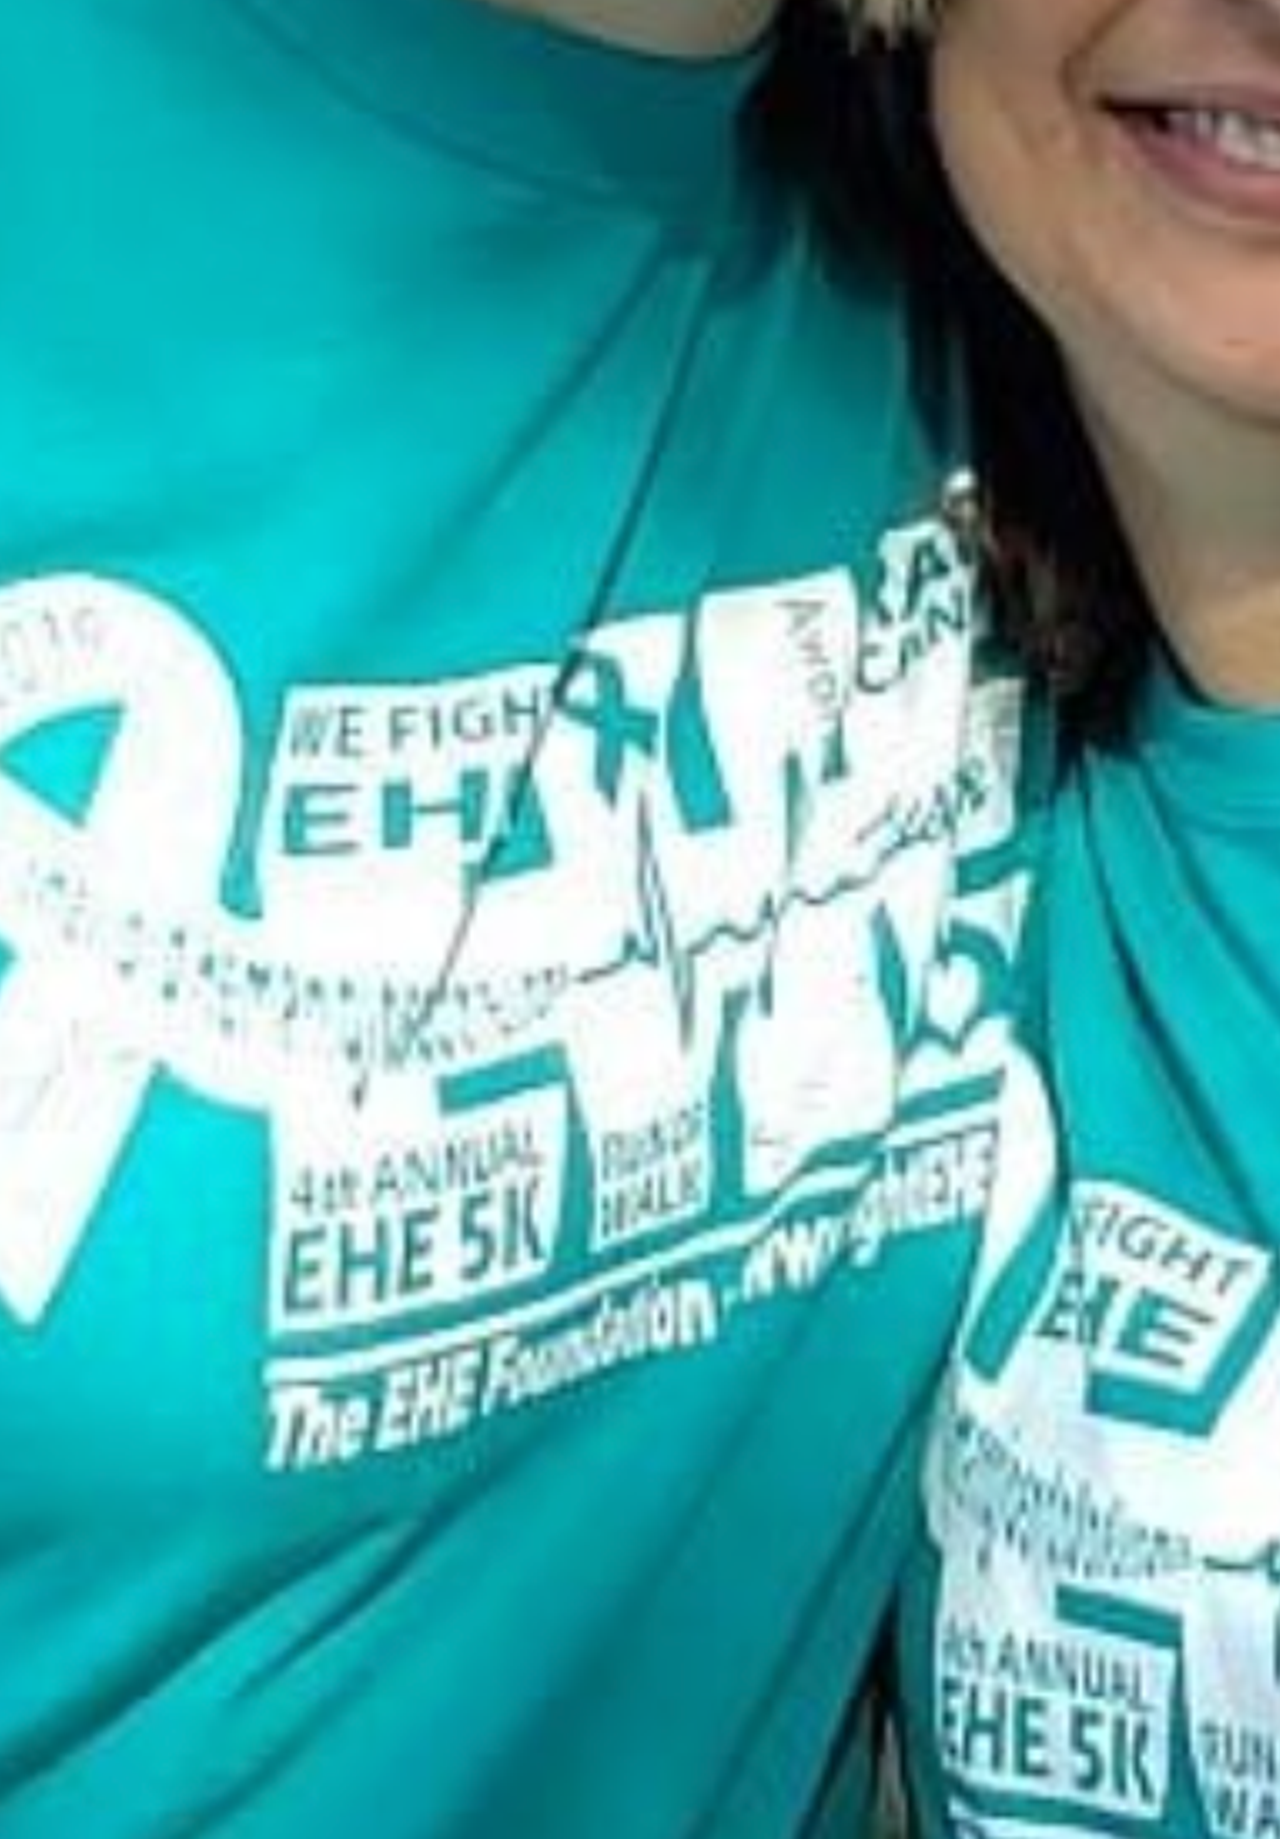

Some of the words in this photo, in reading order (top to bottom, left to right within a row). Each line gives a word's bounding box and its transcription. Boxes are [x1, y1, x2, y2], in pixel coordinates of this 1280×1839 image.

[289, 703, 370, 758] WE
[386, 683, 544, 753] FIGH
[282, 766, 489, 858] EH
[368, 1115, 548, 1202] ANNUAL
[282, 1203, 442, 1315] EHE
[458, 1170, 548, 1284] 5K
[266, 1381, 371, 1471] The
[374, 1343, 484, 1453] EHE
[480, 1278, 717, 1416] Foundation
[992, 1632, 1158, 1713] ANNUAL
[942, 1674, 1051, 1779] EHE
[1070, 1706, 1157, 1807] 5K
